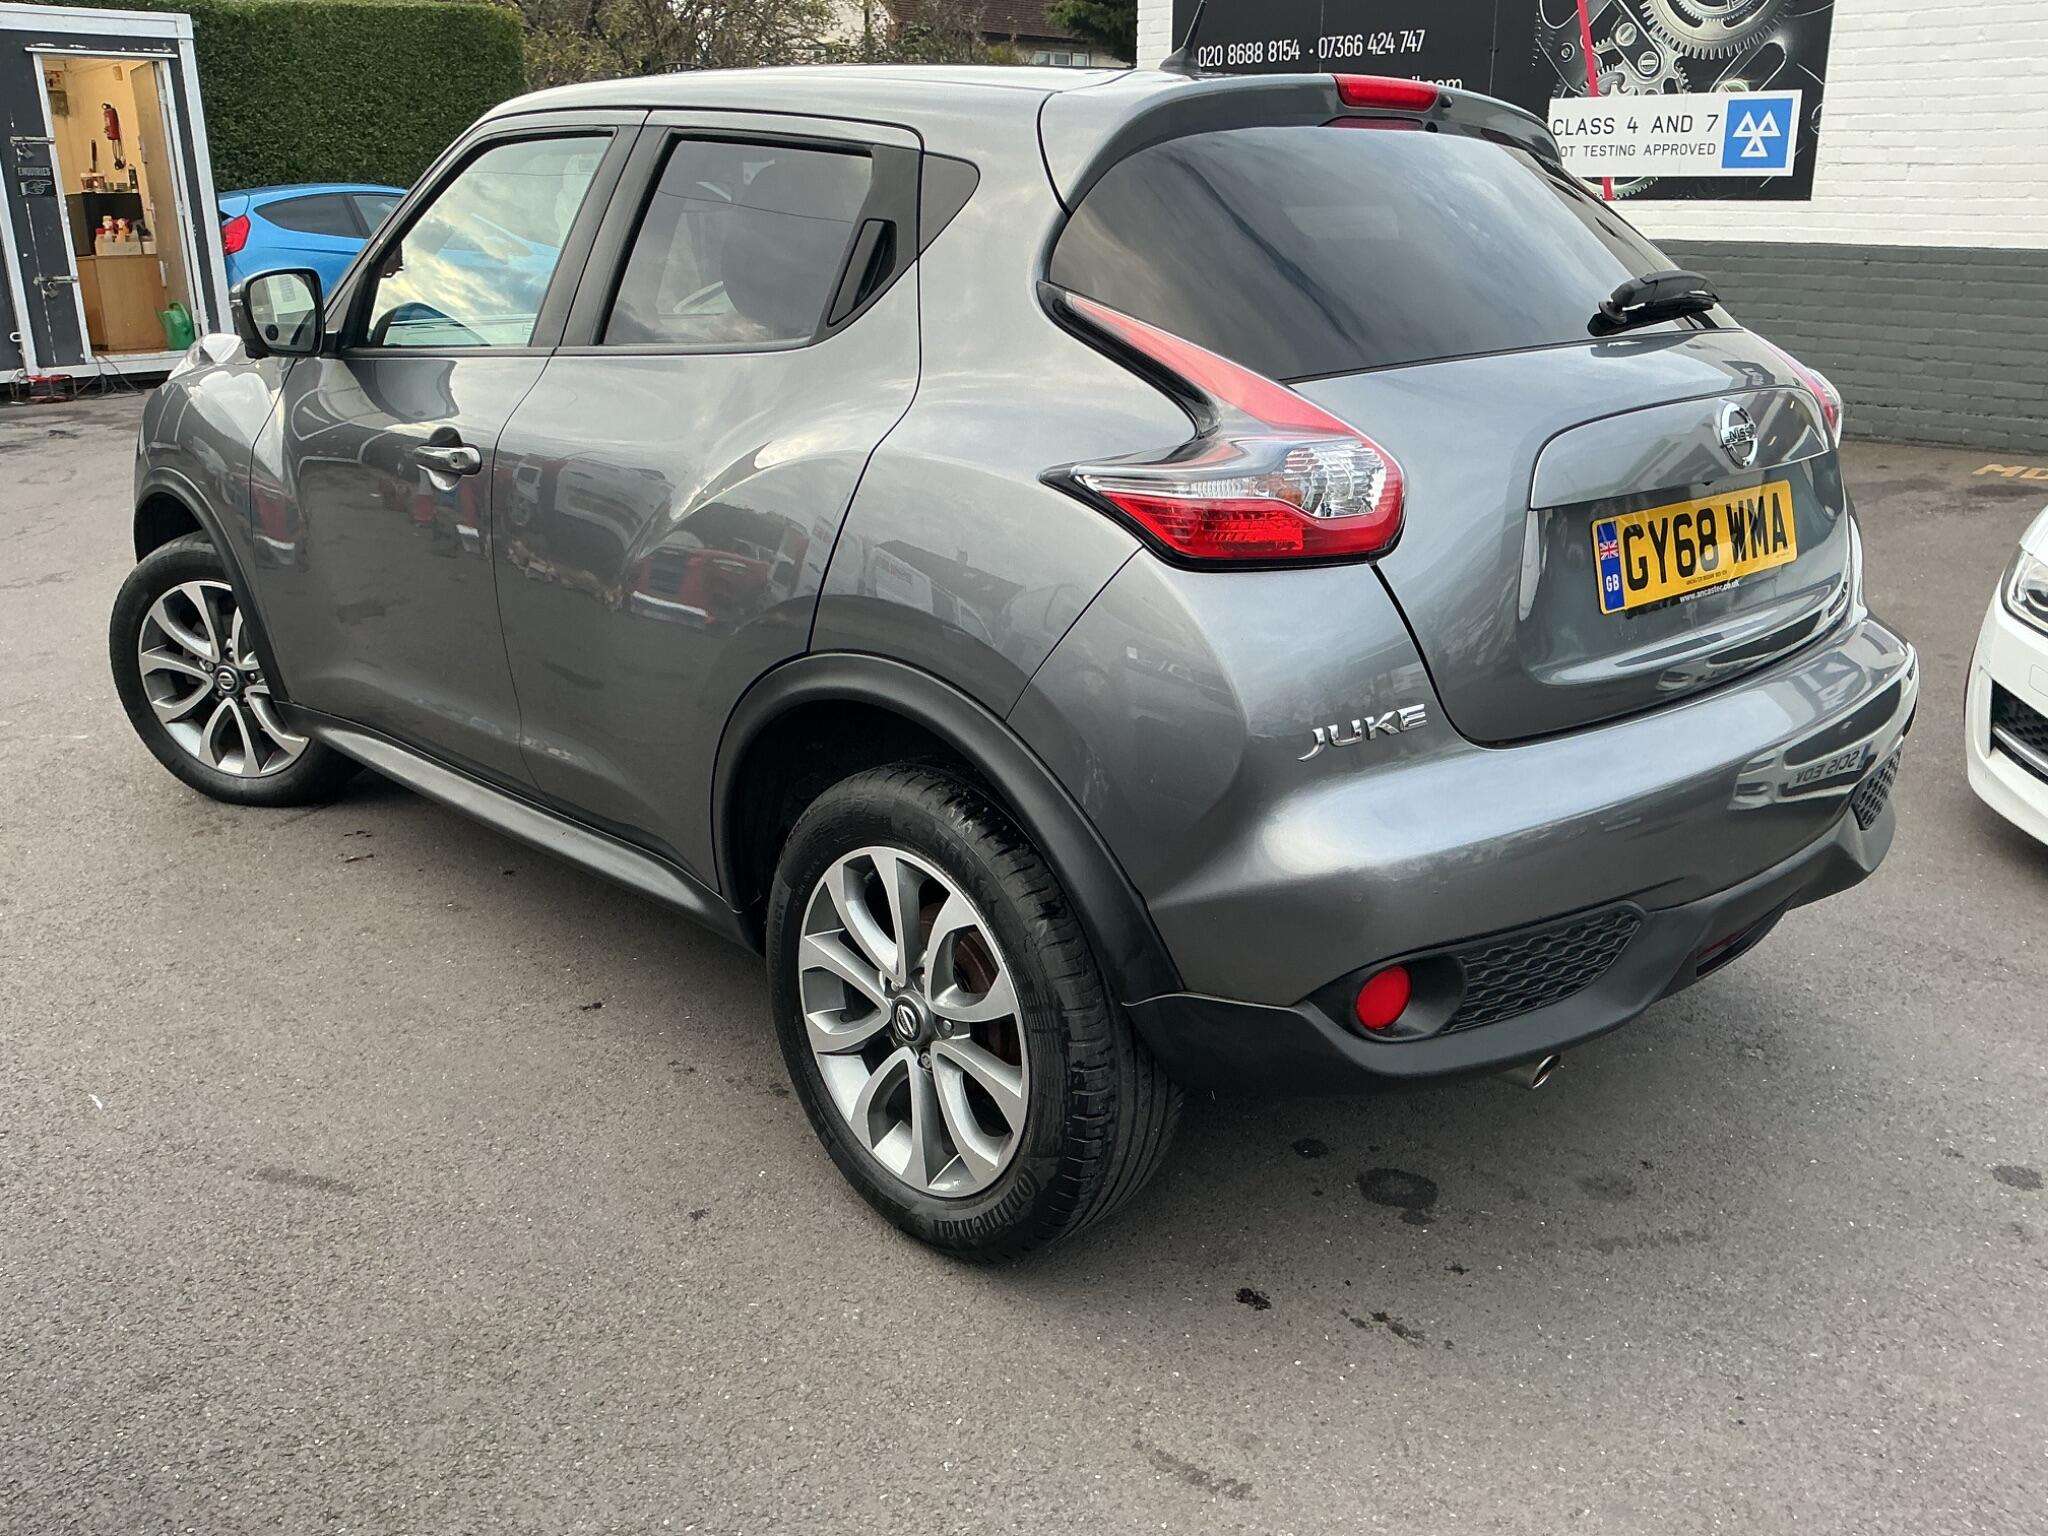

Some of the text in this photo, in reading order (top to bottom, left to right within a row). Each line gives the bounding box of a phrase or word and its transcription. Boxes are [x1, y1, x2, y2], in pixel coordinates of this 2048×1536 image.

[1198, 29, 1425, 67] 020 8688 8154 07366 424 747
[1552, 114, 1719, 136] CLASS 4 AND 7
[1559, 143, 1717, 158] OT TESTING APPROVED
[1622, 492, 1789, 592] GY68 WMA
[1605, 573, 1620, 593] GB
[1296, 703, 1428, 763] JUKE
